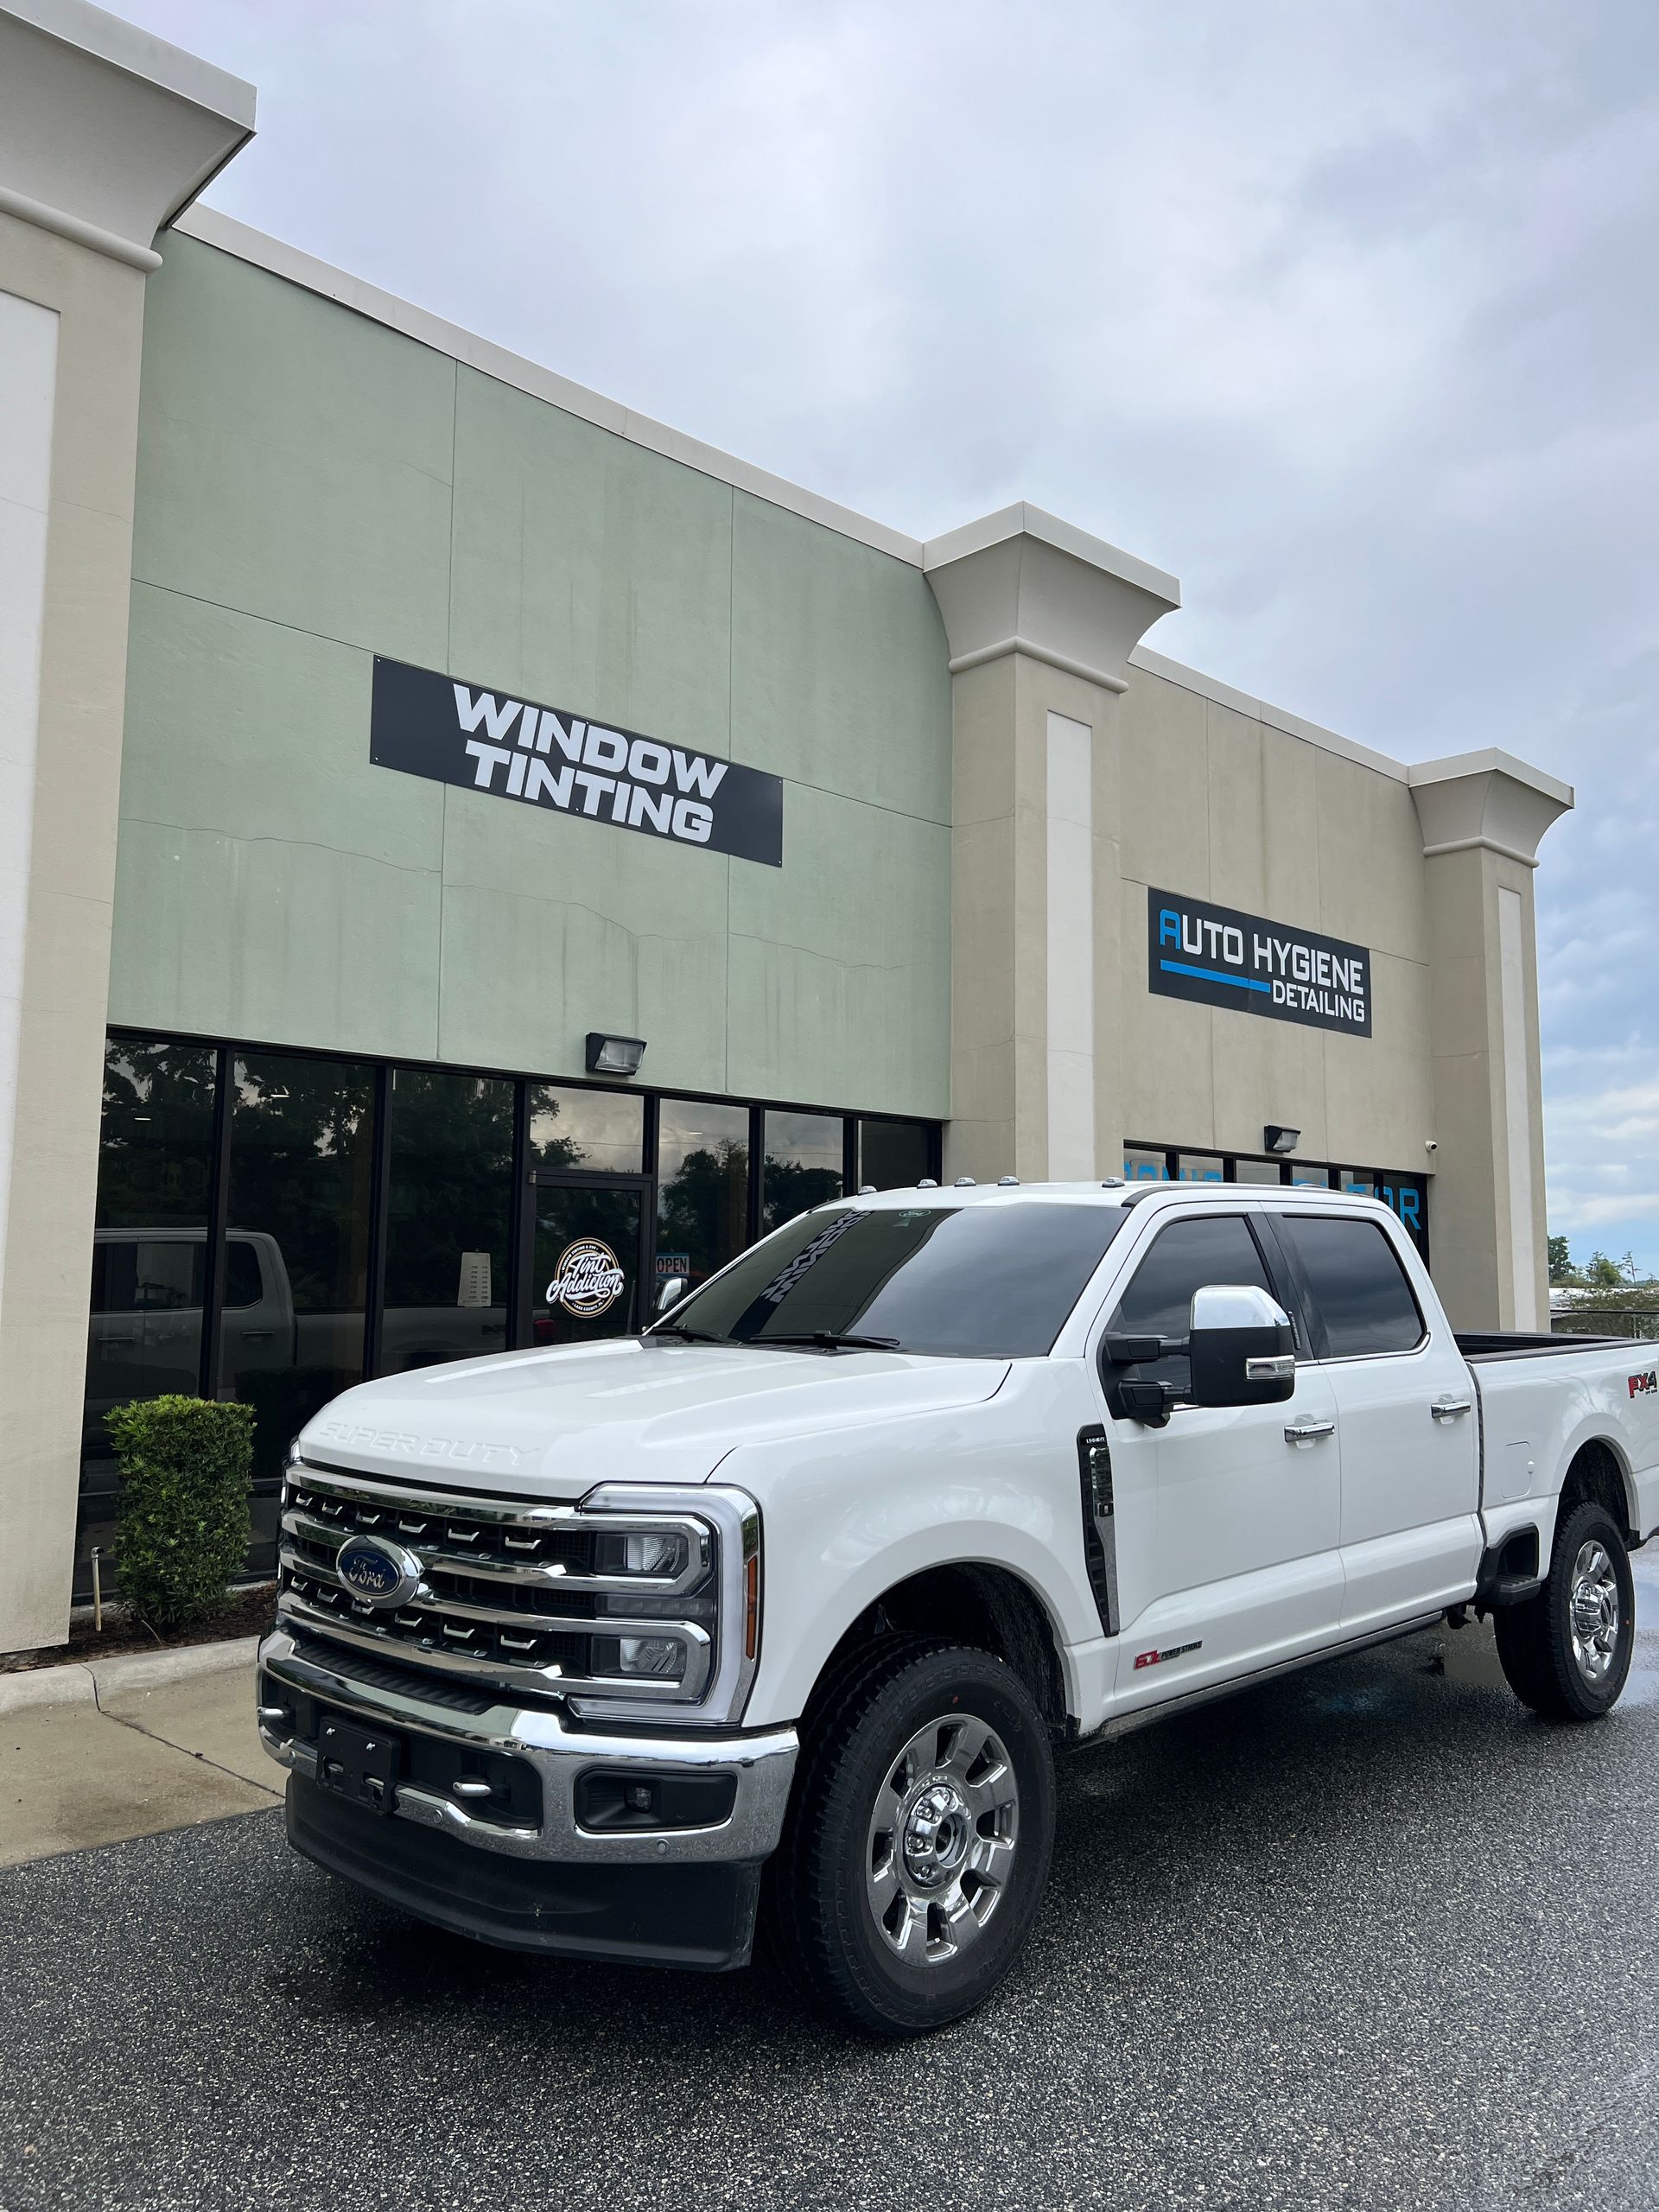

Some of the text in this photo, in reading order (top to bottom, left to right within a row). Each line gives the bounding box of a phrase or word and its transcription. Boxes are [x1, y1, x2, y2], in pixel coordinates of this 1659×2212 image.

[453, 683, 728, 798] WINDOW
[465, 740, 714, 843] TINTING
[1160, 909, 1363, 995] AUTO HYGIENE
[1273, 979, 1365, 1022] DETAILING
[569, 1252, 612, 1279] Tint
[657, 1257, 687, 1273] OPEN
[546, 1268, 625, 1304] Addiction
[1628, 1370, 1657, 1398] FX4
[318, 1421, 540, 1465] SUPER DUTY
[349, 1555, 386, 1588] Ford
